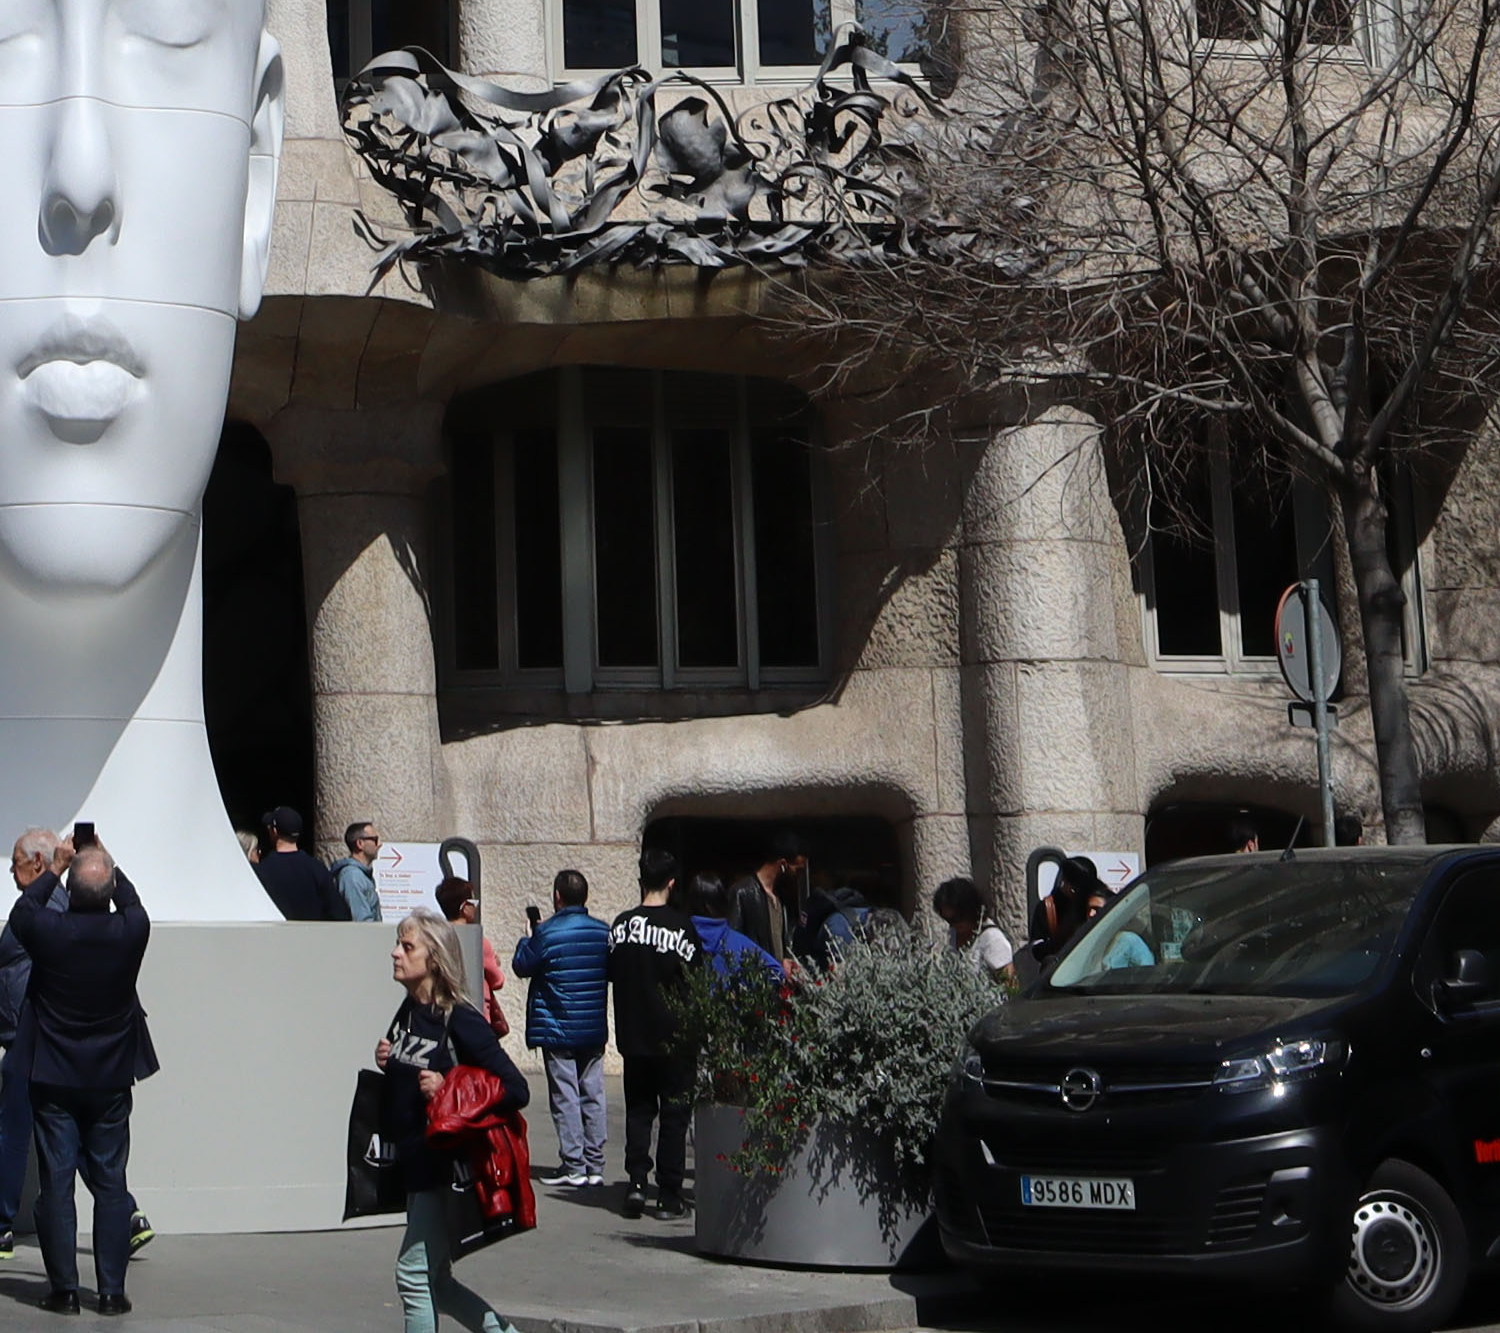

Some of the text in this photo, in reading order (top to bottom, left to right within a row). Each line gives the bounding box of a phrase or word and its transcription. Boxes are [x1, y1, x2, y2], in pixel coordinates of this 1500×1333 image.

[627, 915, 697, 962] Angeles
[1033, 1180, 1130, 1206] 9586 MDX
